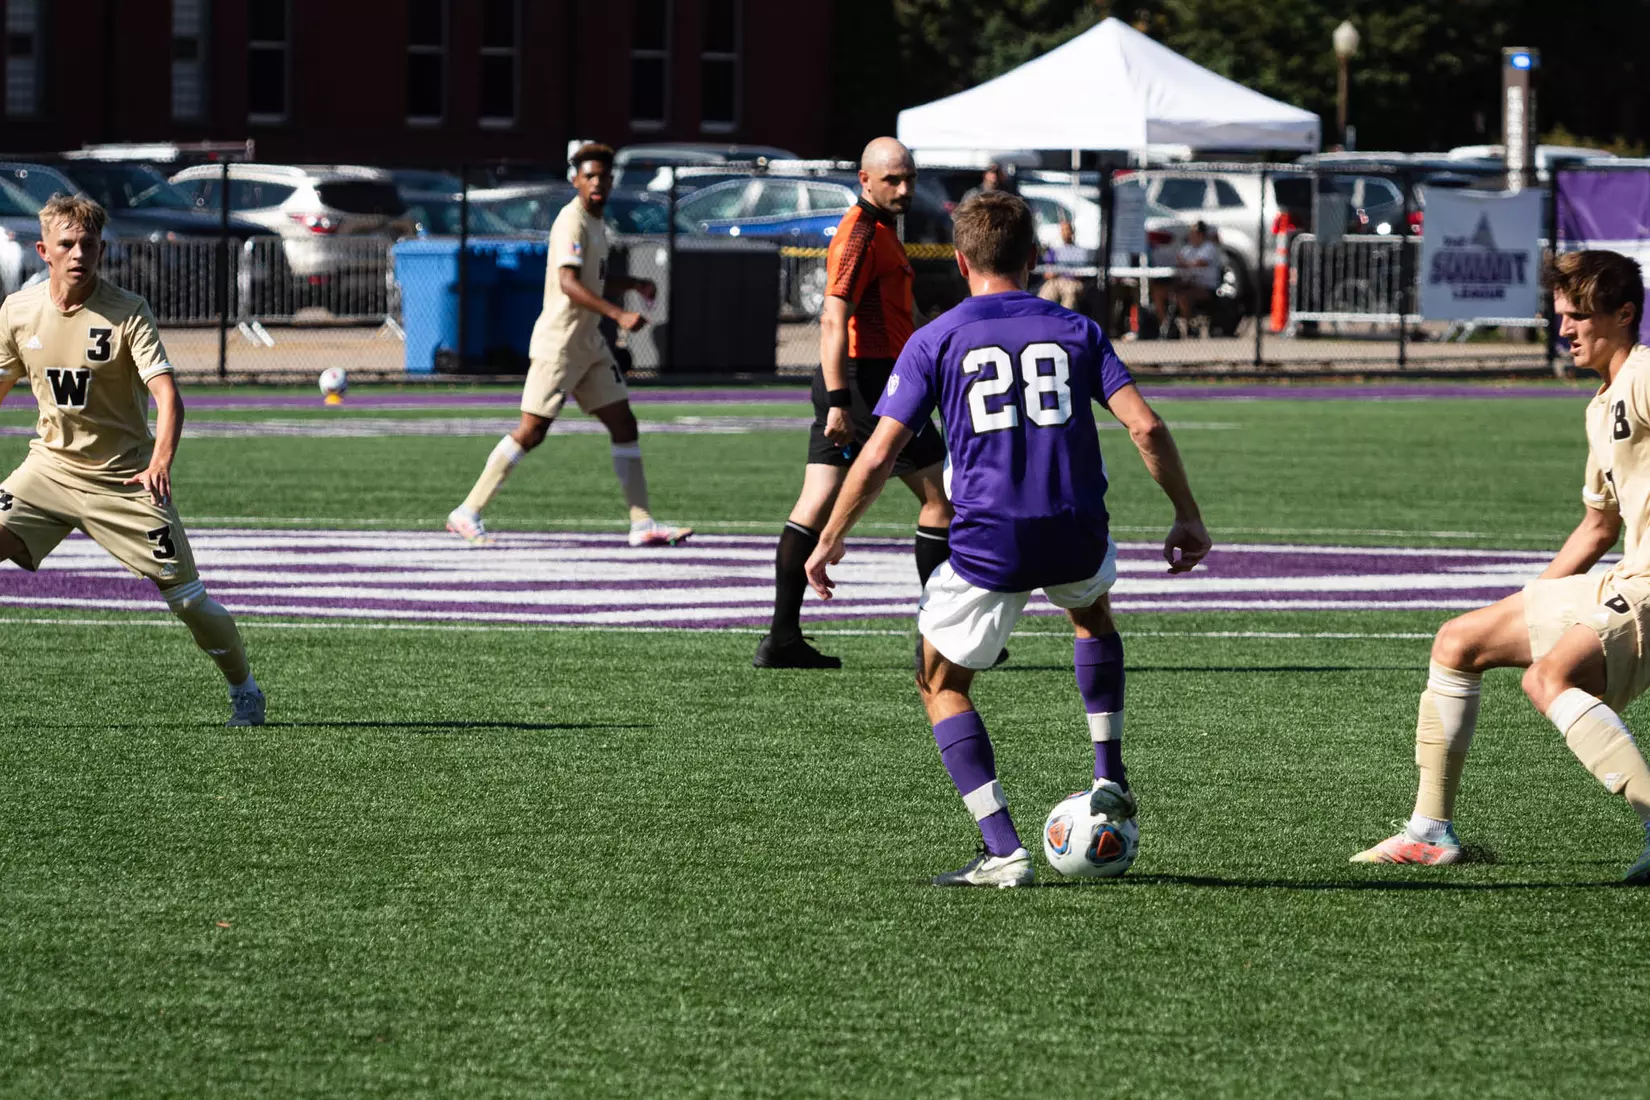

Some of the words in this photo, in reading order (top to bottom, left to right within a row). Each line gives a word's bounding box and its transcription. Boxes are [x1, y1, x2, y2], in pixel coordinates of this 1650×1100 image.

[86, 327, 113, 363] 3
[45, 368, 92, 409] W
[961, 340, 1074, 435] 28
[1610, 399, 1632, 441] 8
[147, 524, 176, 560] 3
